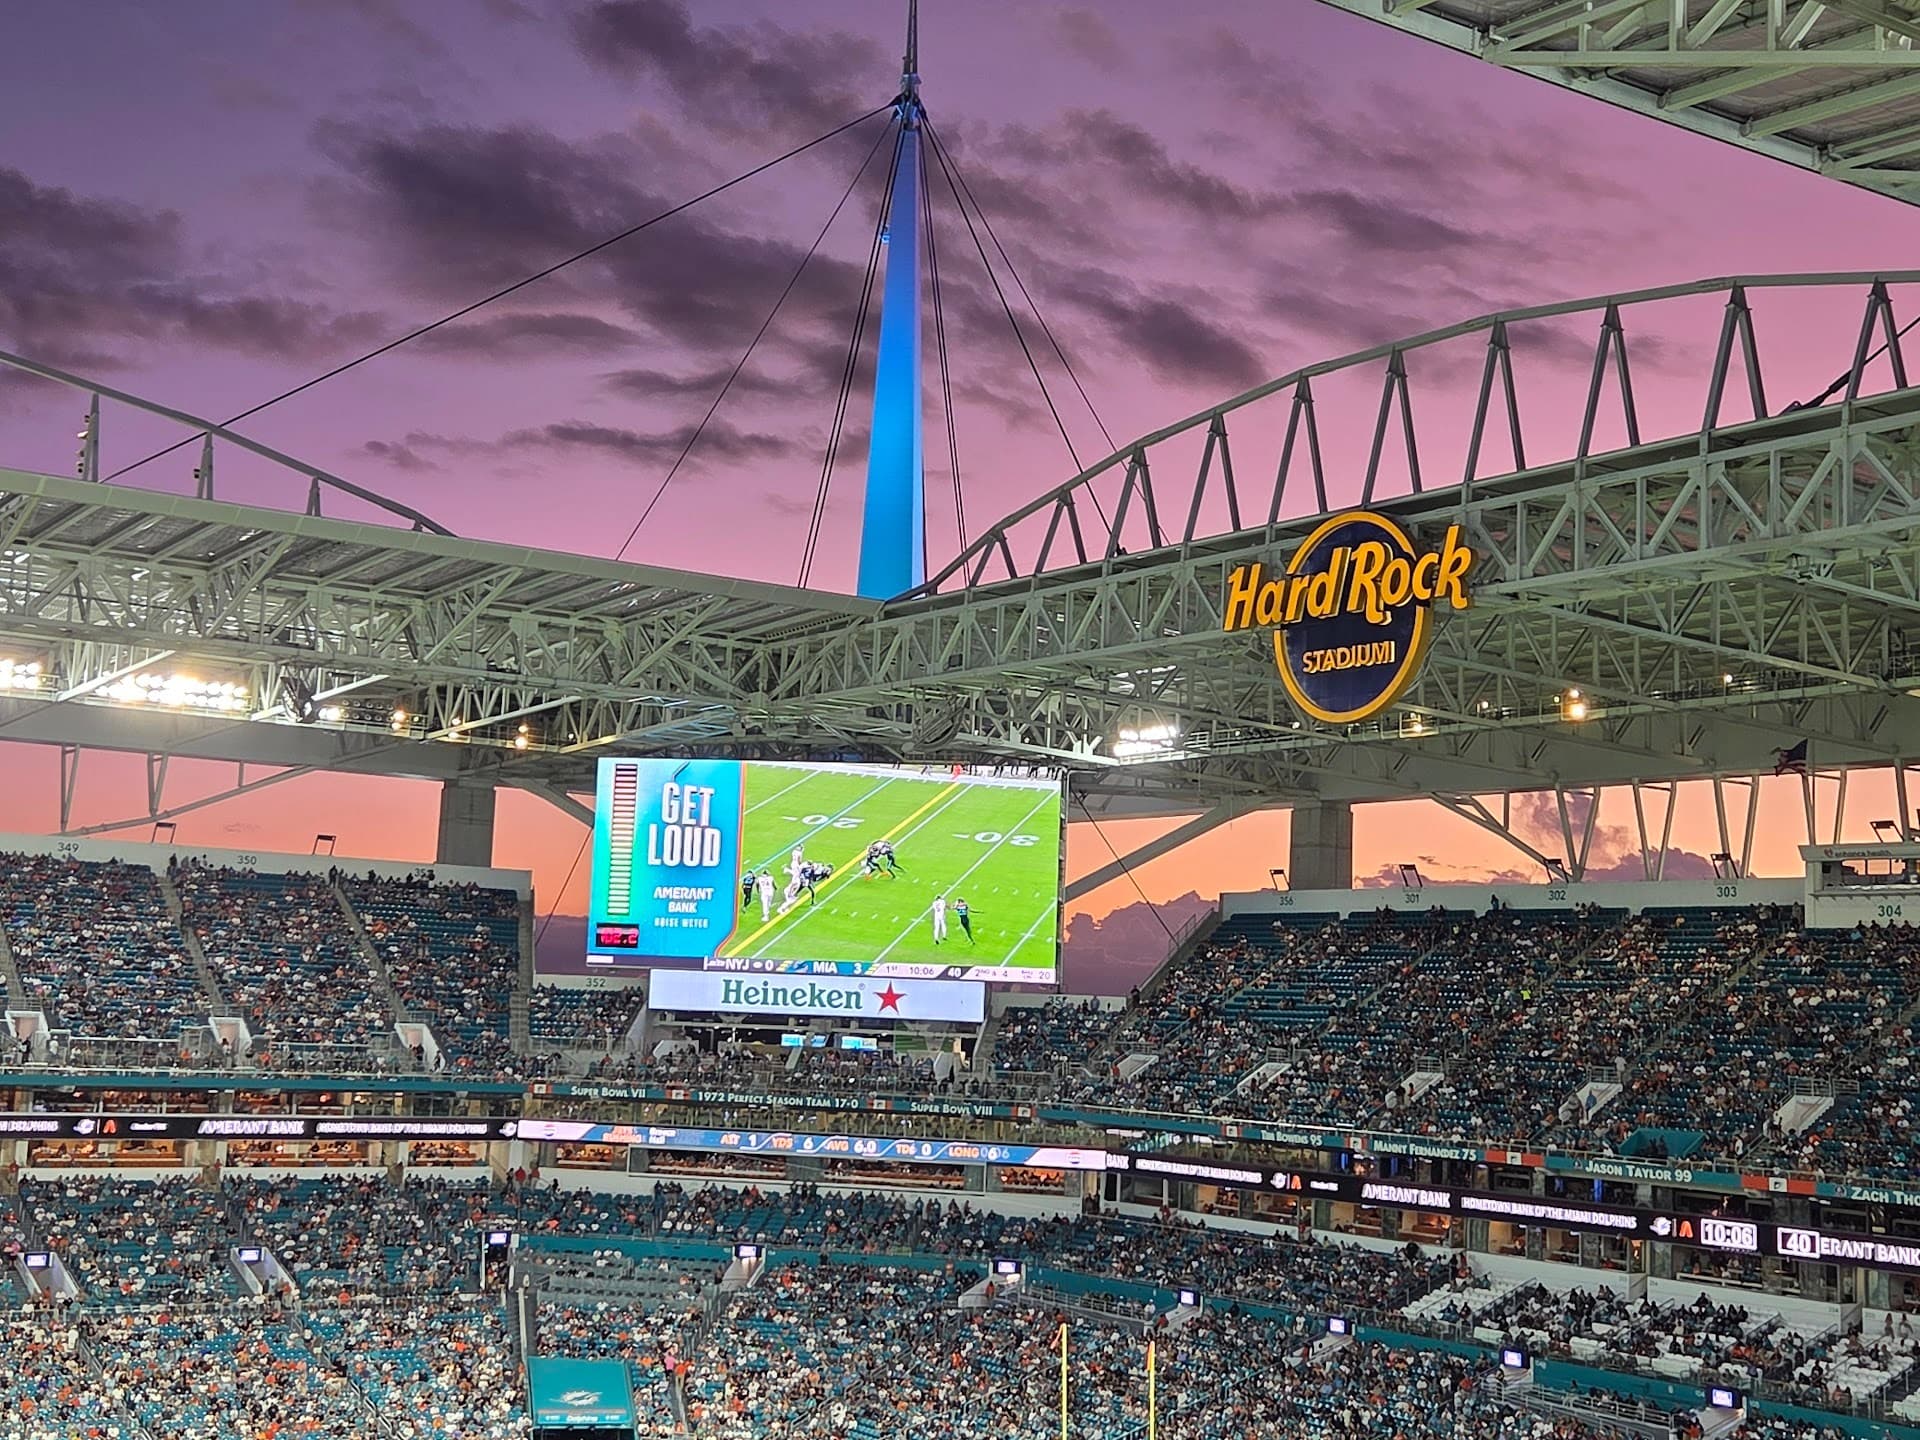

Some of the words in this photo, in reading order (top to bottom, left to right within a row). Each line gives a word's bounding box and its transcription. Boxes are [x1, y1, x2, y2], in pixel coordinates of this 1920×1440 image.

[1223, 547, 1351, 632] Hard
[1346, 524, 1473, 625] Rock
[1302, 641, 1395, 674] STADIUM
[661, 782, 715, 827] GET
[57, 842, 79, 852] 349
[647, 824, 721, 867] LOUD
[237, 856, 257, 865] 350
[414, 868, 434, 878] 35
[653, 886, 714, 901] AMERANT
[1548, 890, 1566, 900] 302
[1716, 886, 1737, 897] 303
[1405, 894, 1419, 904] 301
[668, 901, 697, 913] BANK
[1878, 905, 1902, 917] 304
[726, 958, 749, 971] NYJ
[765, 960, 773, 971] 0
[813, 962, 838, 973] MIA
[854, 963, 862, 974] 3
[586, 978, 606, 988] 352
[721, 978, 863, 1010] Heineken
[571, 1086, 599, 1097] SUPER
[601, 1086, 628, 1097] BOWL
[631, 1088, 646, 1098] VII
[698, 1091, 725, 1102] 1972
[727, 1092, 764, 1104] PERFECT
[766, 1094, 803, 1106] SEASON
[806, 1096, 831, 1107] TEAM
[834, 1098, 859, 1109] 17-0
[910, 1101, 940, 1113] SUPER
[942, 1103, 970, 1115] BOWL
[973, 1105, 993, 1116] VIII
[748, 1134, 757, 1147] 1
[803, 1137, 813, 1150] 6
[1310, 1134, 1323, 1146] 95
[826, 1140, 849, 1152] AVG
[854, 1140, 877, 1154] 6.0
[949, 1146, 980, 1159] LONG
[1373, 1140, 1407, 1154] MANNY
[1409, 1143, 1460, 1159] FERNANDEZ
[1462, 1148, 1477, 1161] 75
[1585, 1160, 1622, 1176] JASON
[1626, 1165, 1671, 1181] TAYLOR
[1674, 1169, 1692, 1182] 99
[1361, 1183, 1419, 1205] AMERANT
[1418, 1190, 1450, 1208] BANK
[1851, 1186, 1889, 1203] ZACH
[1461, 1197, 1511, 1214] HOMETOWN
[1511, 1204, 1535, 1217] BANK
[1546, 1207, 1564, 1220] THE
[1565, 1209, 1592, 1223] MIAMI
[1592, 1211, 1637, 1229] DOLPHINS
[1704, 1223, 1753, 1246] 10:06
[1786, 1232, 1812, 1253] 40
[1874, 1244, 1920, 1266] BANK
